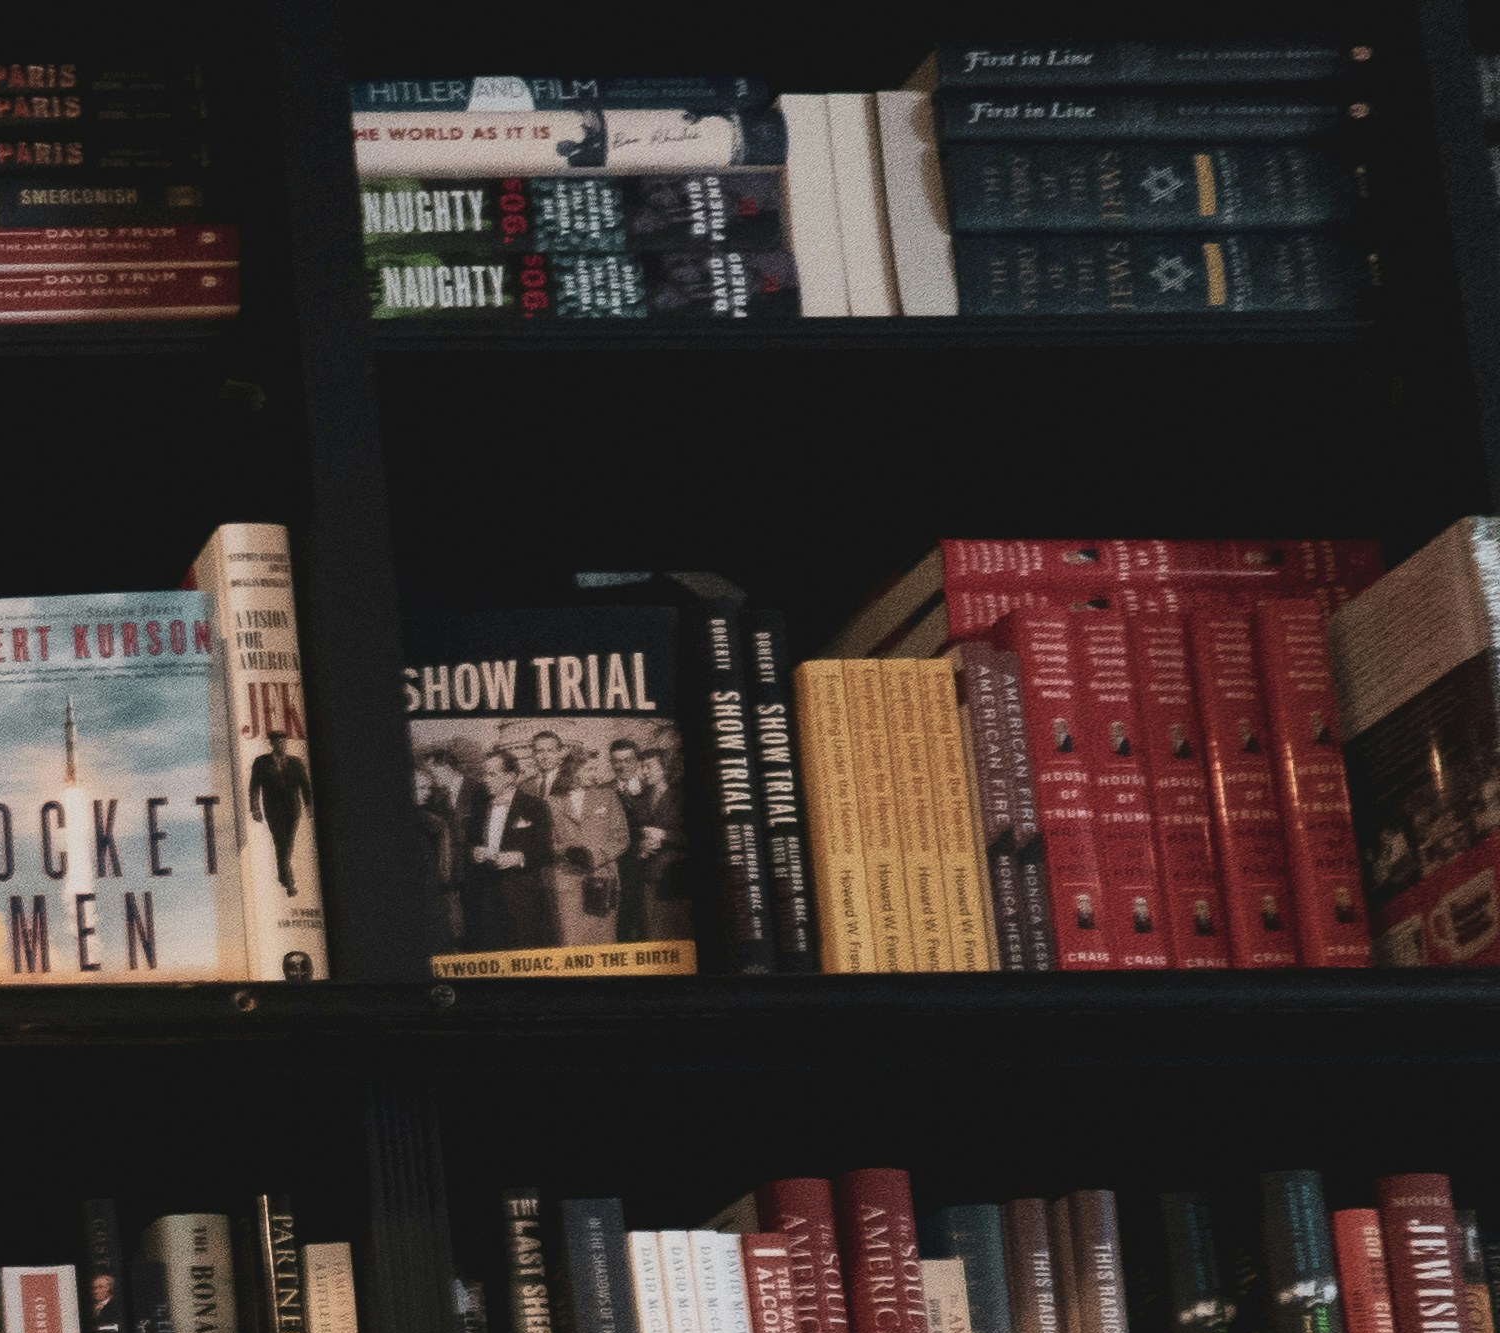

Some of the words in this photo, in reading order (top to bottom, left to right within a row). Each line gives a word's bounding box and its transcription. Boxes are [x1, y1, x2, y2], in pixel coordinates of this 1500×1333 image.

[383, 265, 505, 310] NAUGHTY
[74, 617, 213, 659] KURSON
[406, 662, 524, 713] SHOW
[533, 653, 656, 711] TRIAL
[10, 892, 158, 974] MEN
